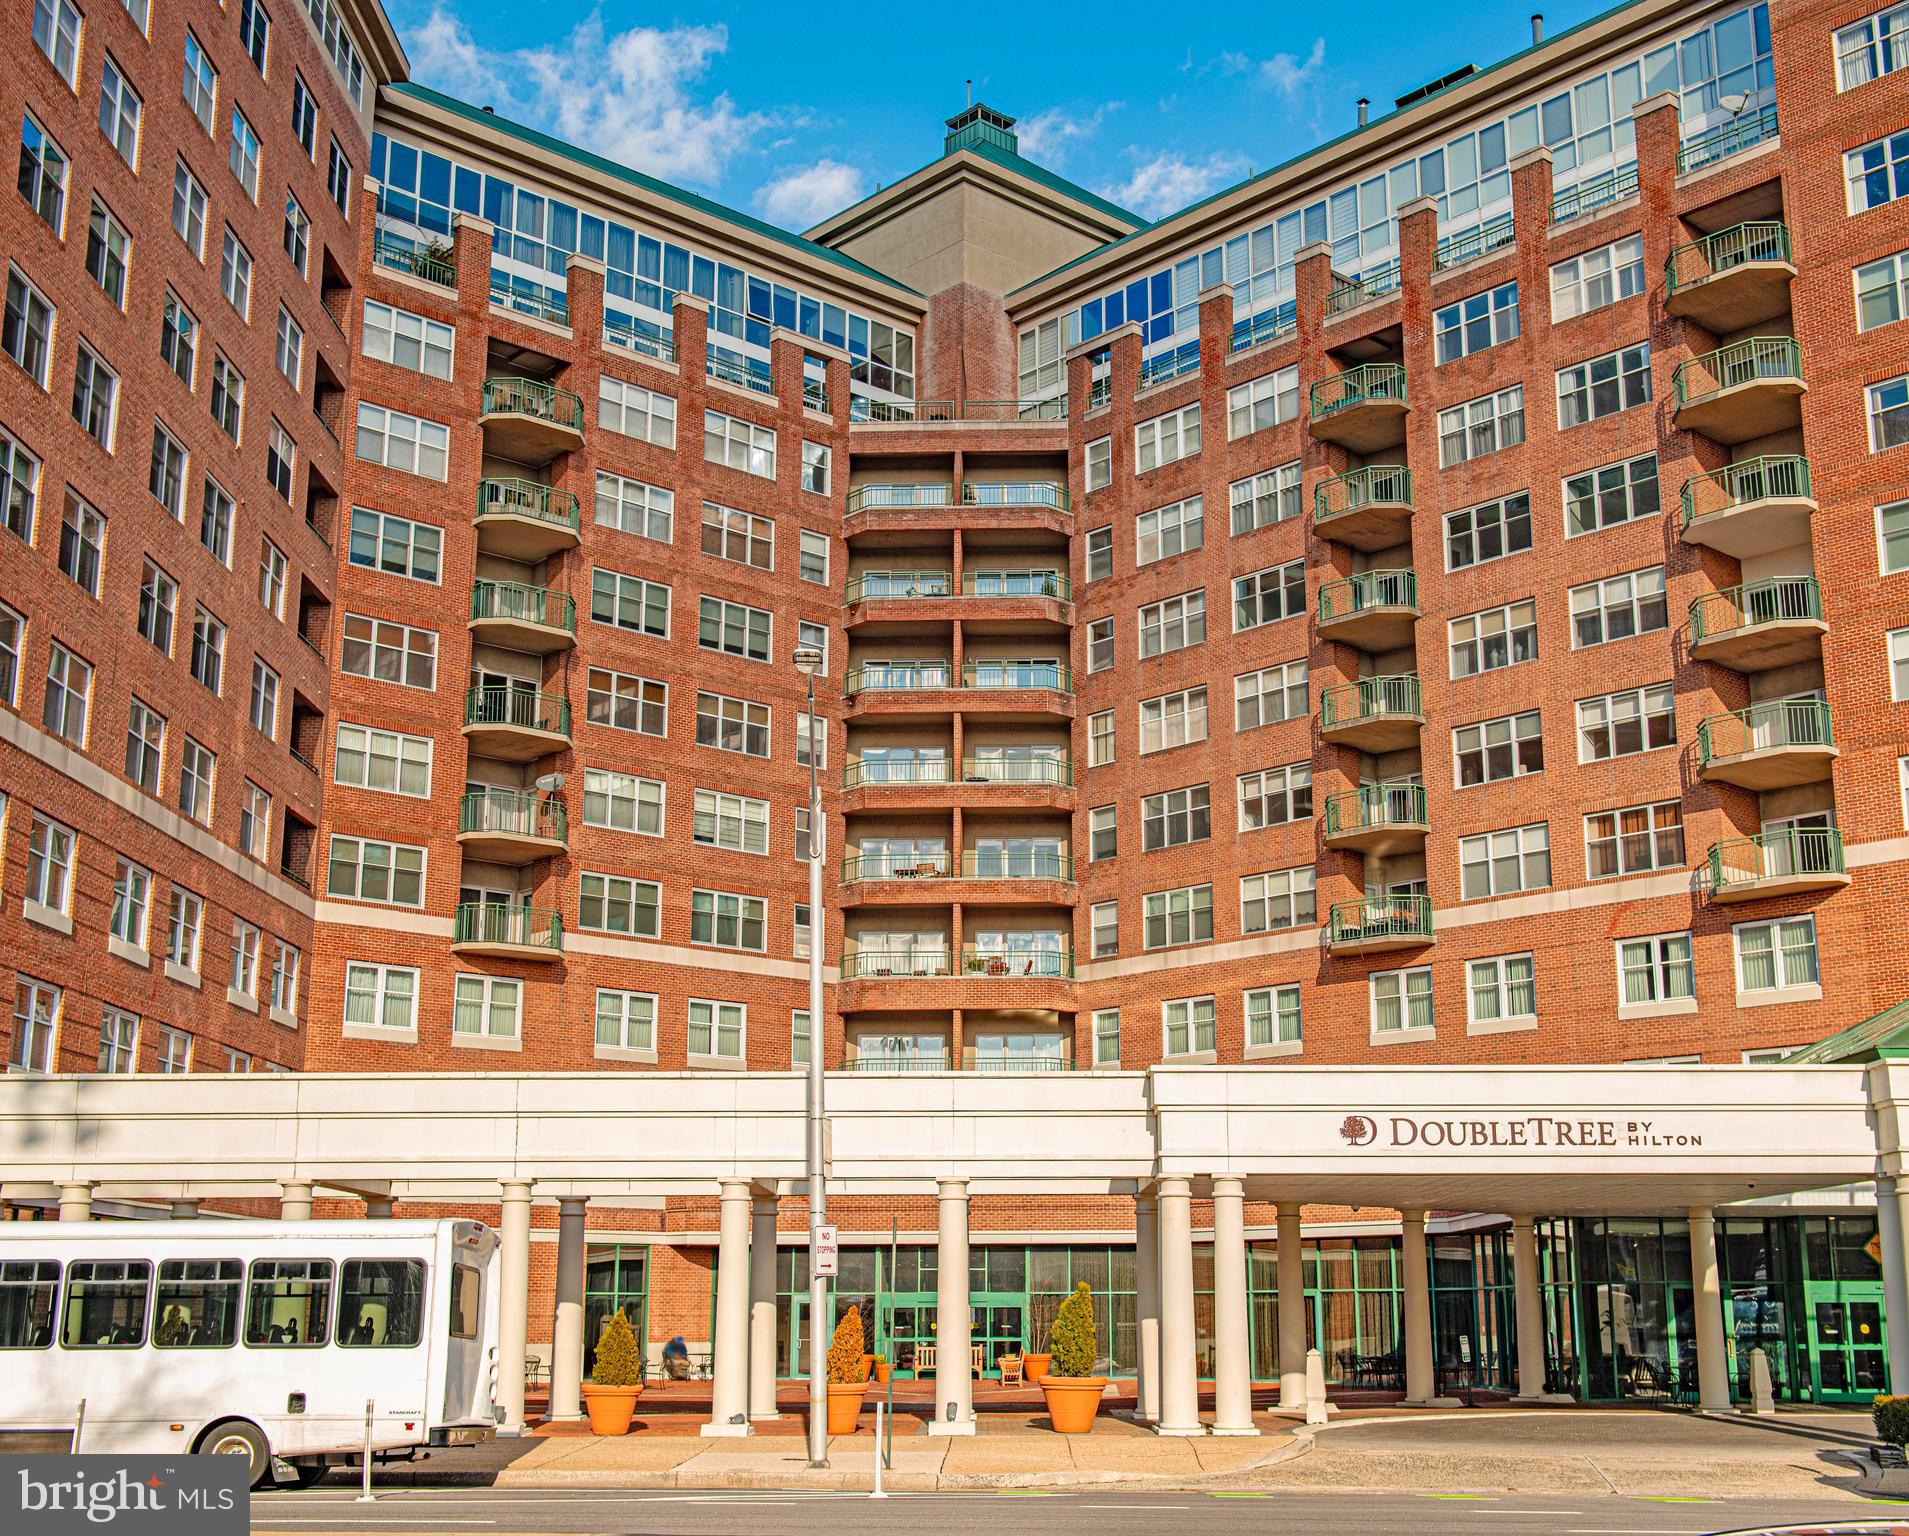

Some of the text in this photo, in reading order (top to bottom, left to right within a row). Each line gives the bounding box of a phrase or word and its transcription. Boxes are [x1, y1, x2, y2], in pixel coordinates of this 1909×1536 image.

[1627, 1122, 1653, 1132] BY
[1628, 1135, 1702, 1146] HILTON
[821, 1232, 831, 1241] NO
[816, 1245, 836, 1254] STOPPING
